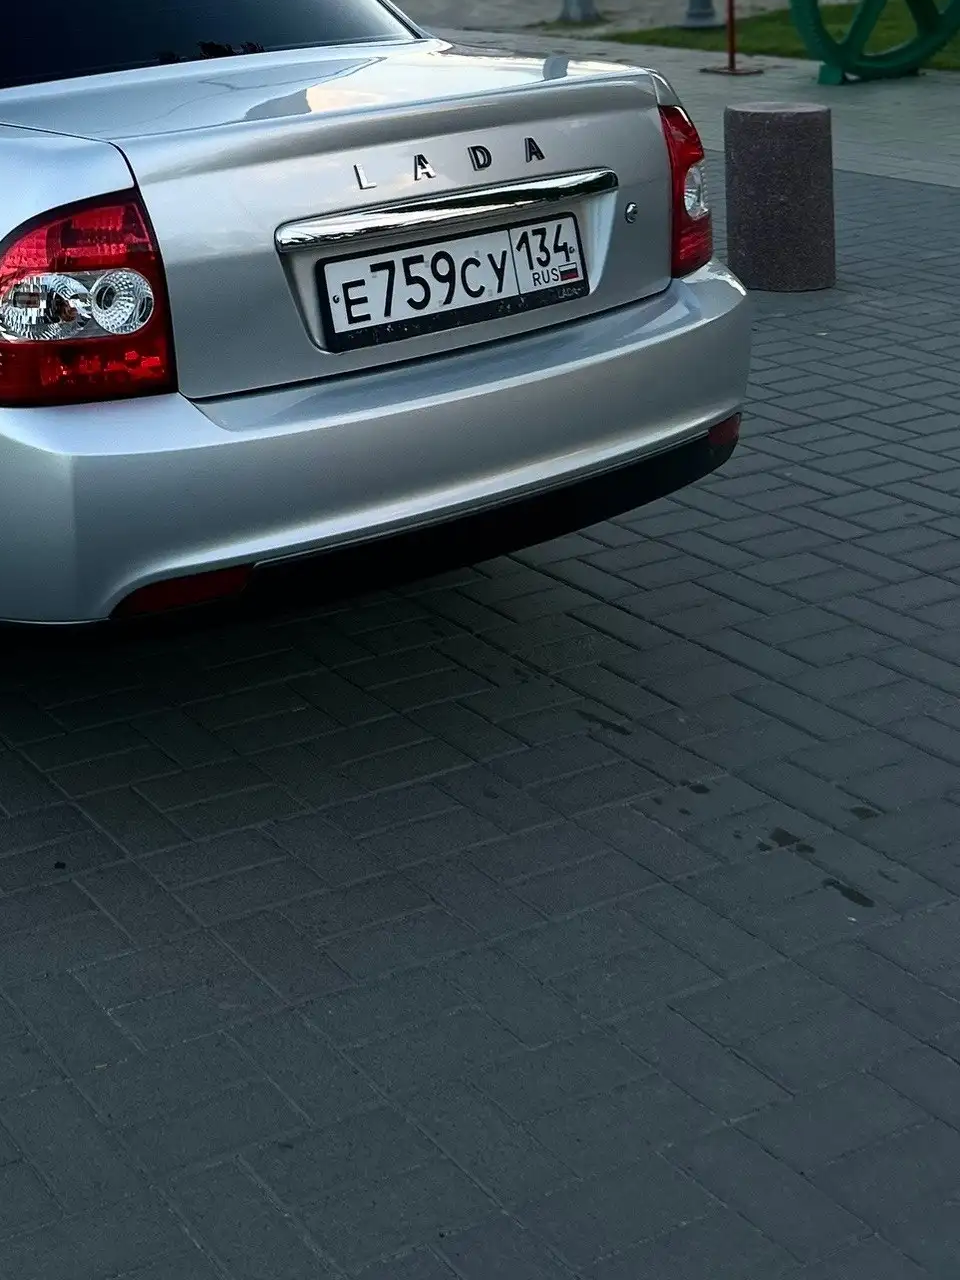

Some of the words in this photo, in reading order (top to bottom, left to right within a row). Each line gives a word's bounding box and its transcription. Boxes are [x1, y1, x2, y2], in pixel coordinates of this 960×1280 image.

[353, 137, 545, 189] LADA
[516, 223, 571, 271] 134
[532, 267, 560, 287] RUS
